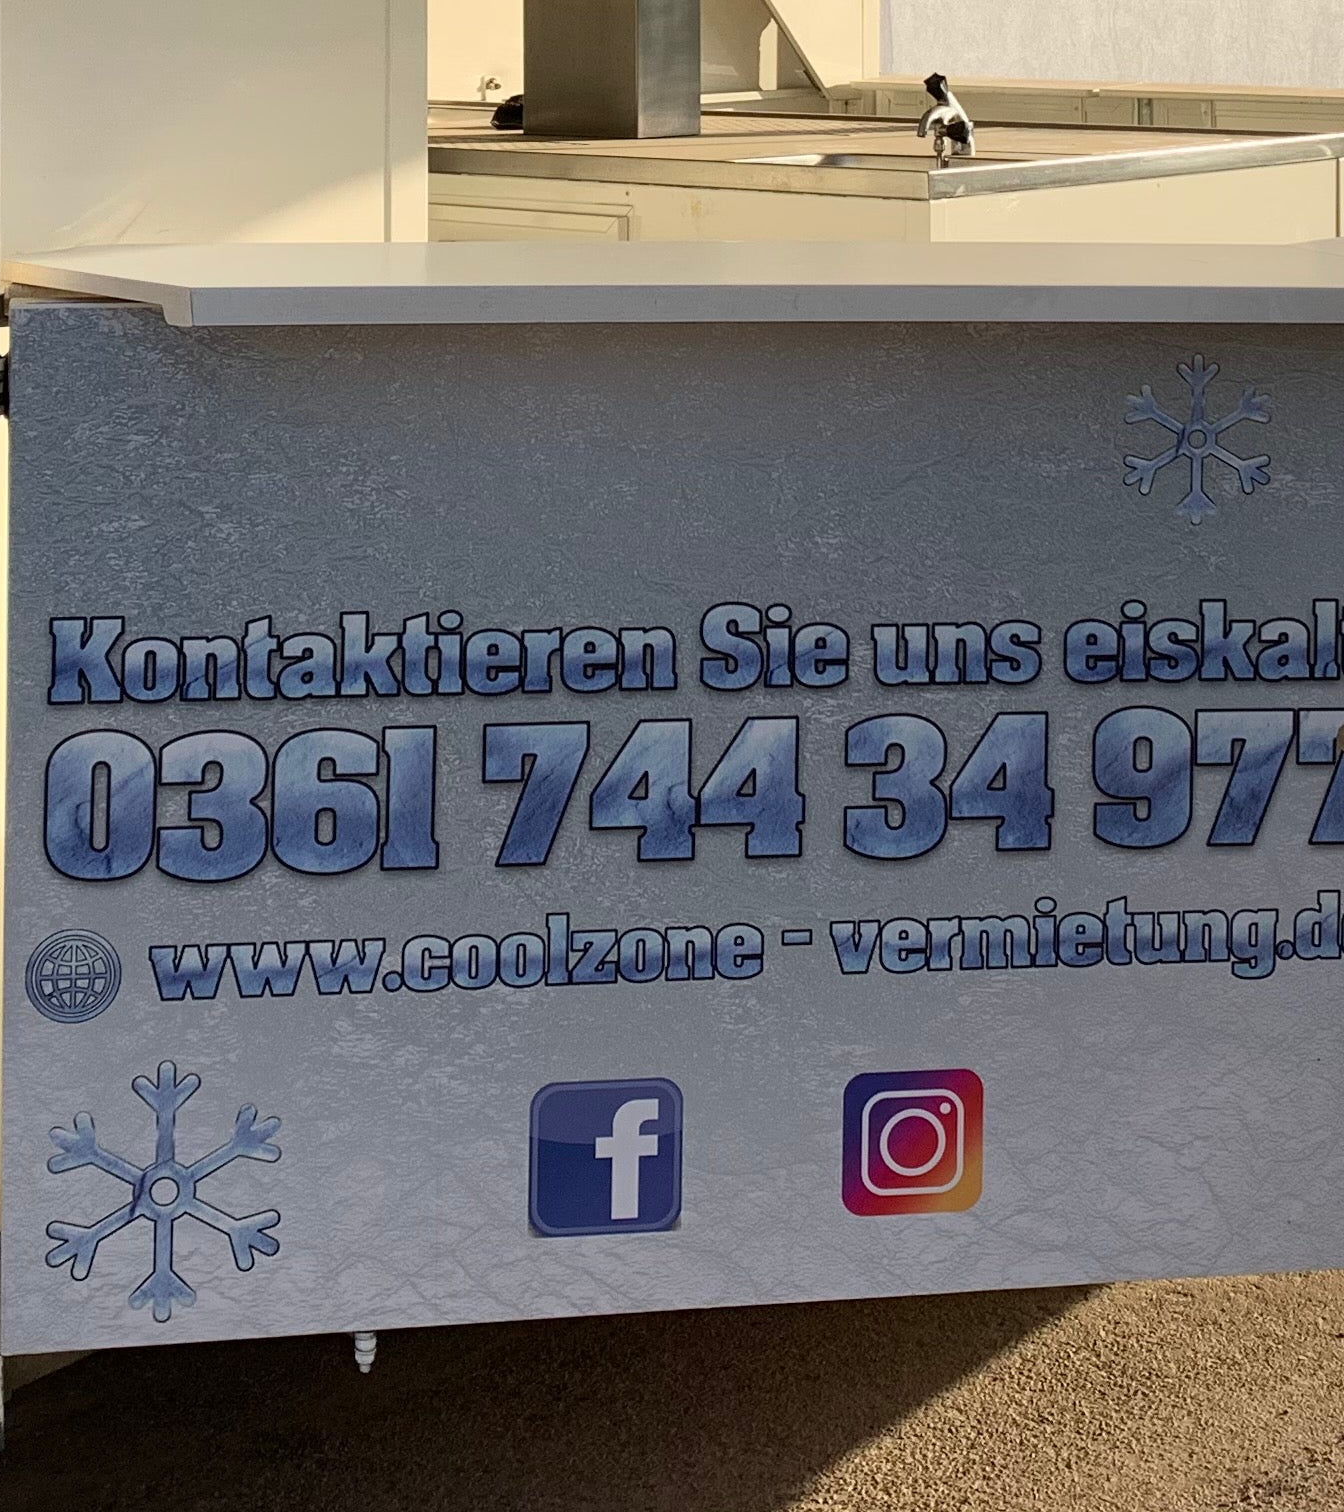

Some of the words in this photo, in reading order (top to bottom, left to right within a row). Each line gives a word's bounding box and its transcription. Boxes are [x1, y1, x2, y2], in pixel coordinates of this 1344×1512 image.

[48, 610, 678, 705] Kontaktieren
[700, 602, 850, 691] Sie
[873, 617, 1041, 686] uns
[44, 725, 440, 883] 0361
[481, 715, 806, 867] 744
[843, 711, 1054, 860] 34
